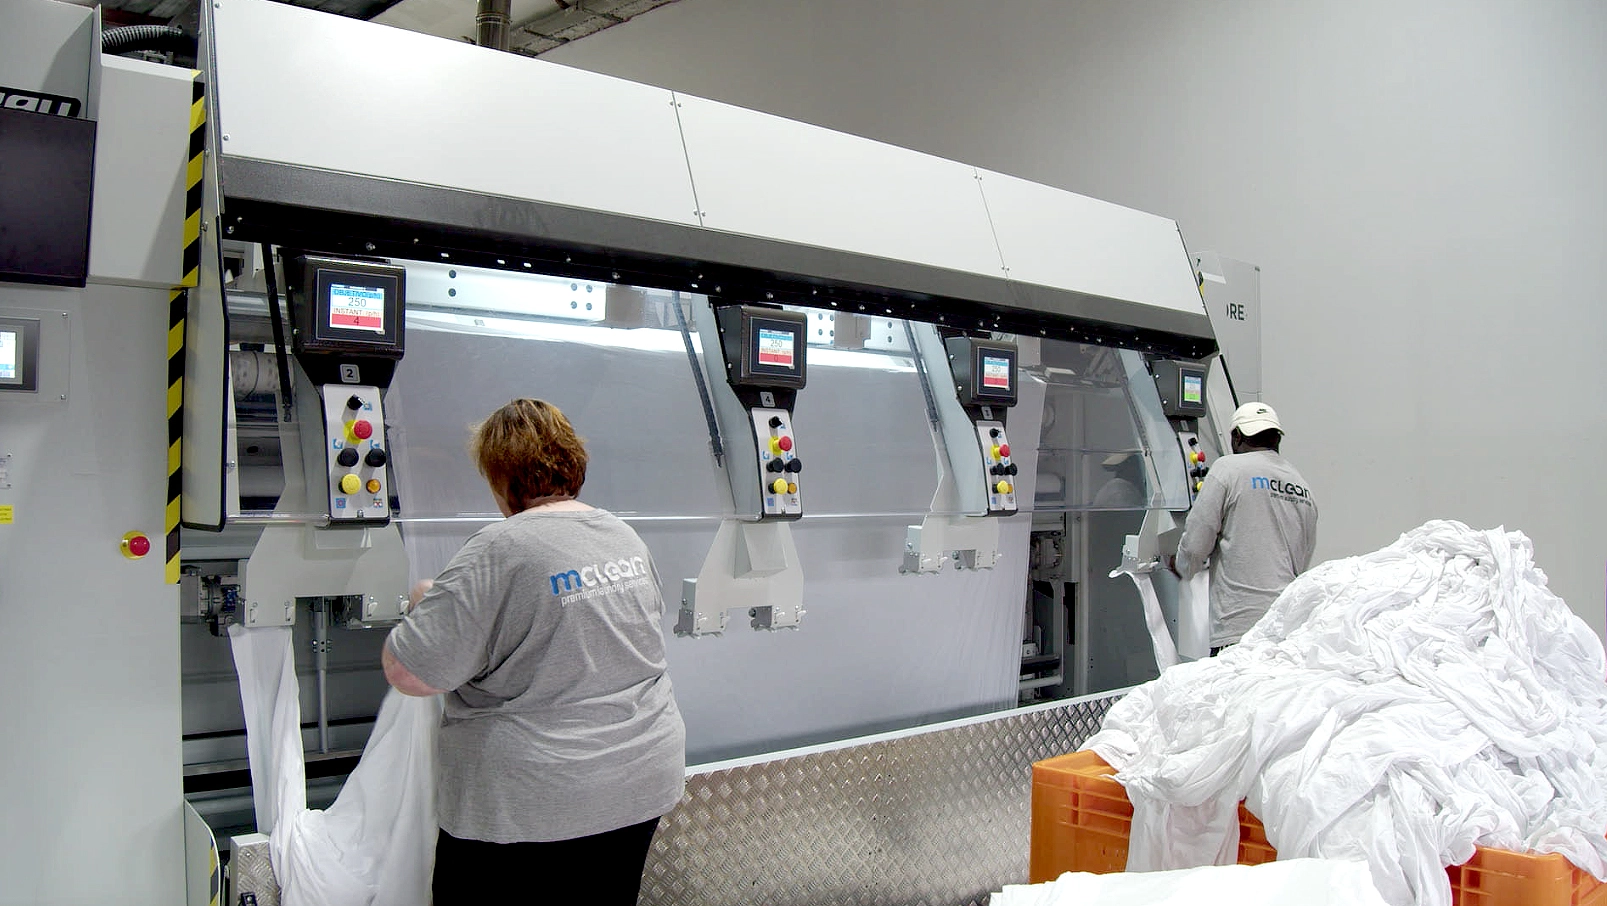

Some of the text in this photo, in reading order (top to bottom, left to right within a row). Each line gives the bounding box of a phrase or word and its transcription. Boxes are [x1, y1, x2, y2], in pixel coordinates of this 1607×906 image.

[348, 296, 367, 308] 250
[333, 307, 362, 317] INSTANT
[1226, 303, 1245, 321] RE
[346, 368, 354, 379] 2
